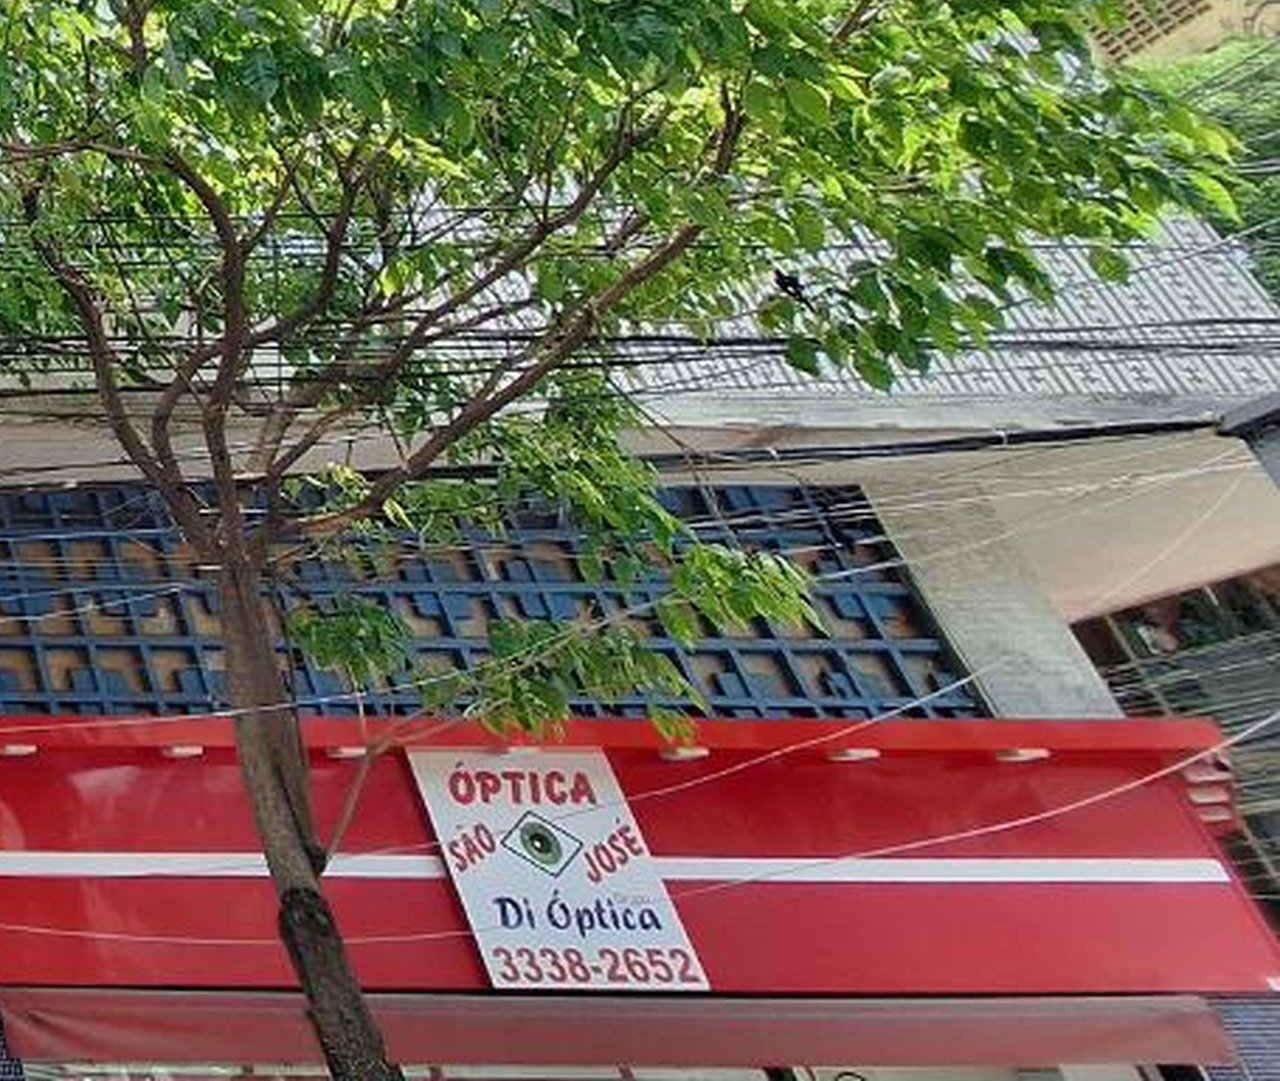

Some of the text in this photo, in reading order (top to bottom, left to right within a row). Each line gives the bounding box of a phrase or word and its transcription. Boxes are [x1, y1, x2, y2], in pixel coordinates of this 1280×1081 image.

[449, 762, 597, 805] ÓPTICA
[449, 818, 640, 883] SÃO JOSÉ
[493, 889, 662, 938] Di Óptica
[493, 948, 700, 983] 3338-2652
